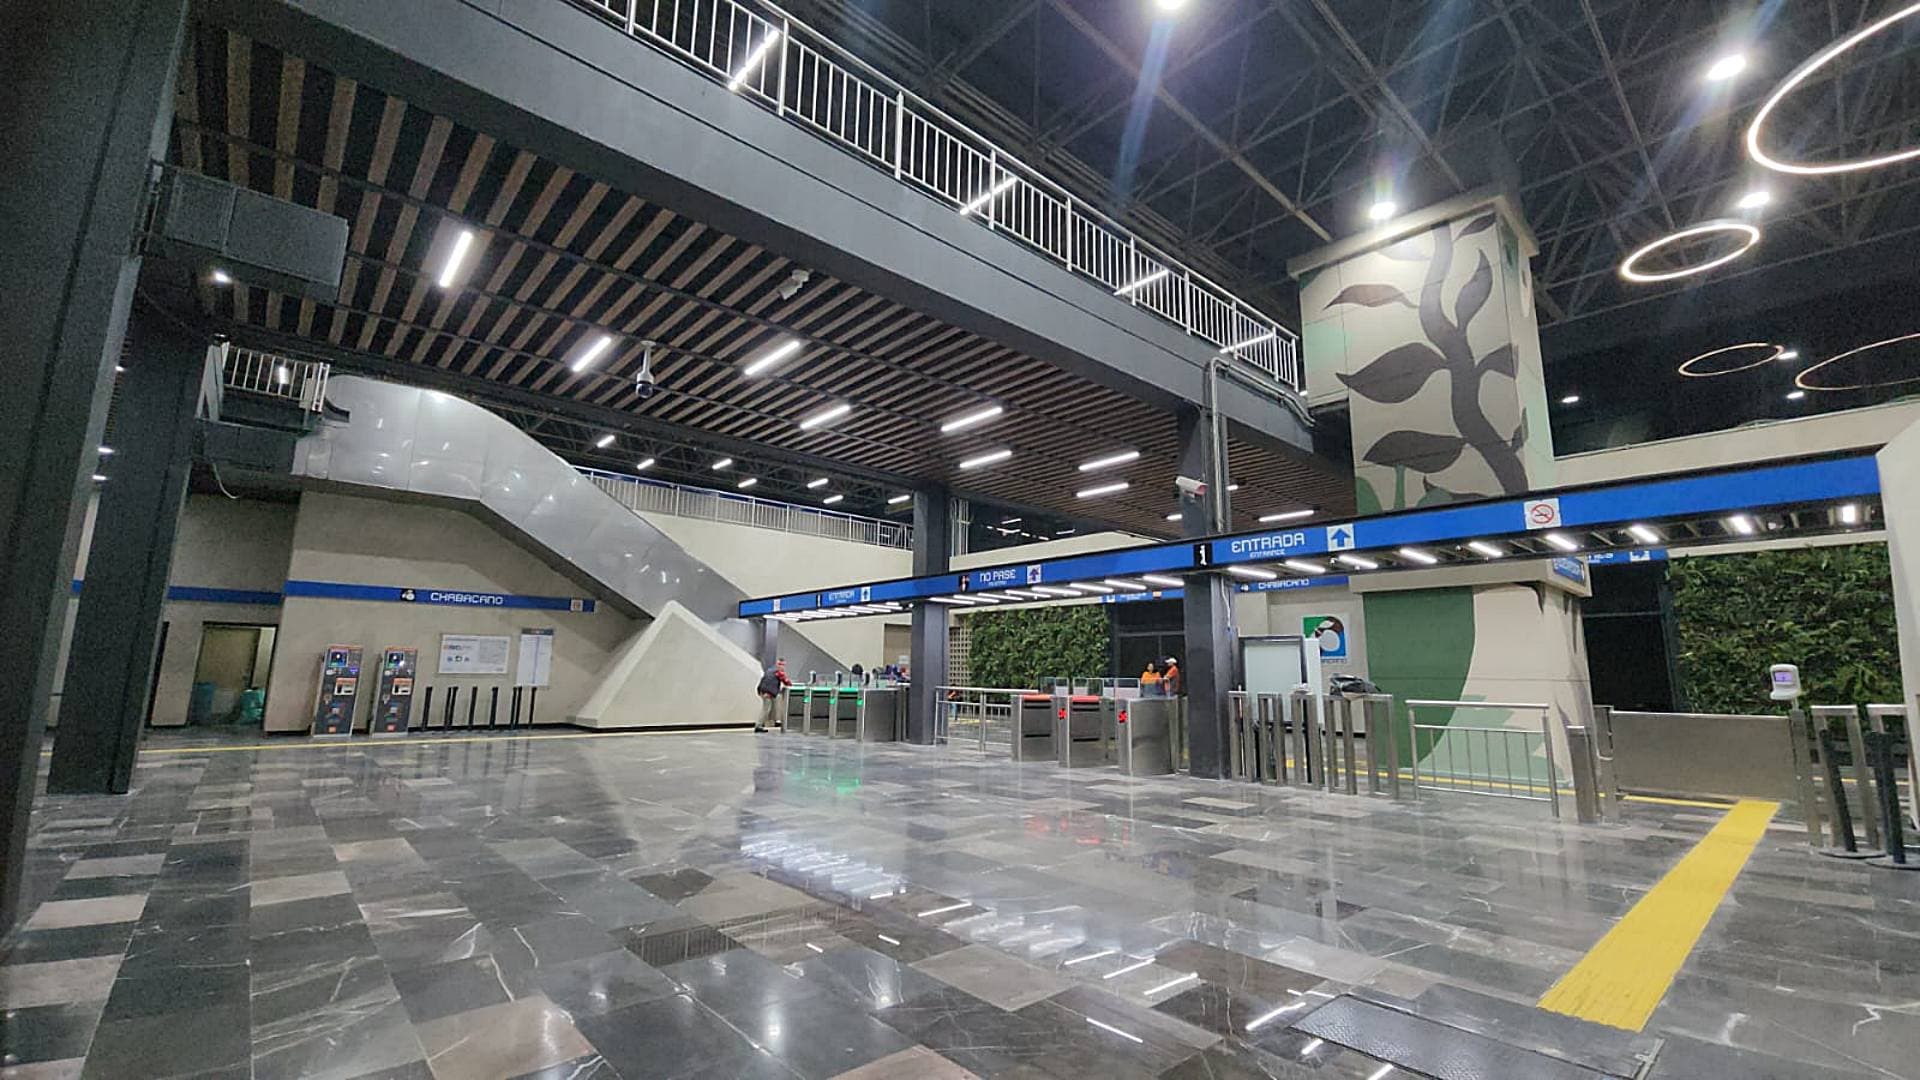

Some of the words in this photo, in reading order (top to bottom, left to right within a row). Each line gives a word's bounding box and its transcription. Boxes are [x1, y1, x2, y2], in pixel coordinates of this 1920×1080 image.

[1231, 533, 1305, 553] ENTRADA
[979, 573, 992, 583] NO
[992, 569, 1016, 580] PASE
[430, 592, 503, 605] CHABACANO
